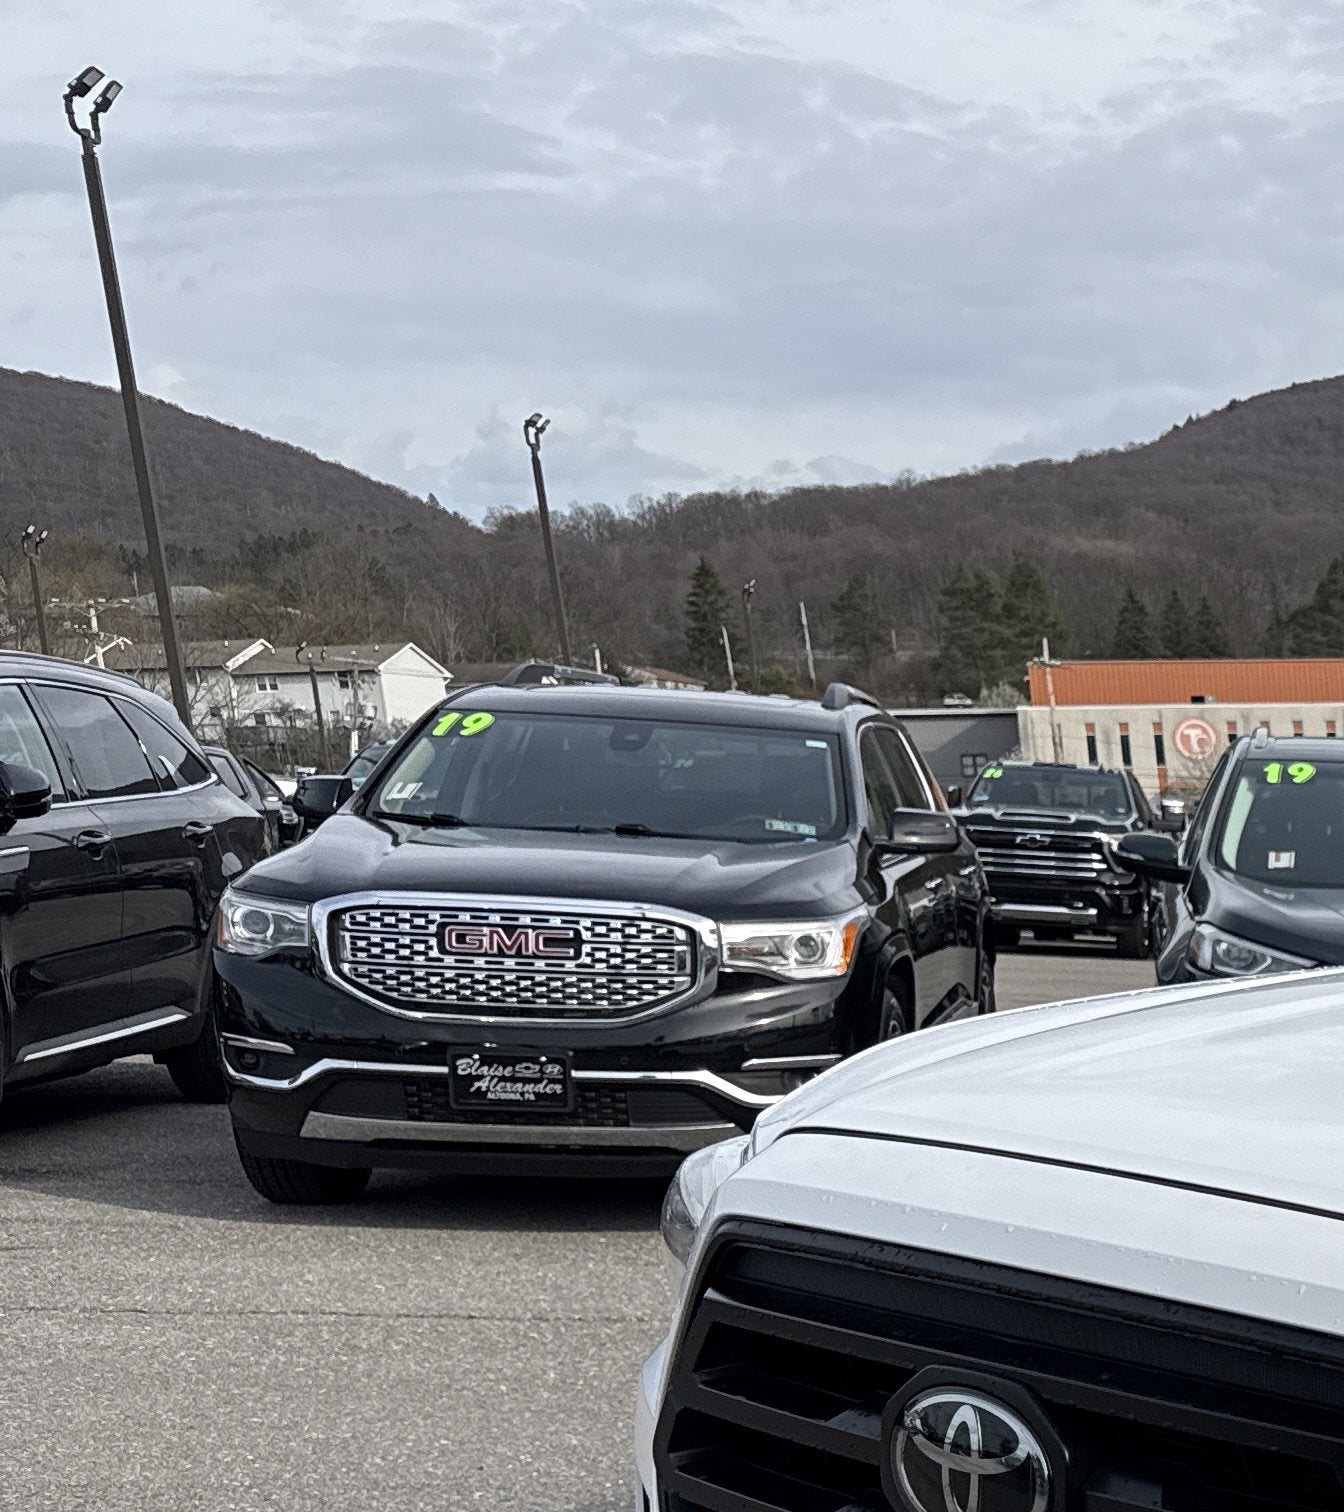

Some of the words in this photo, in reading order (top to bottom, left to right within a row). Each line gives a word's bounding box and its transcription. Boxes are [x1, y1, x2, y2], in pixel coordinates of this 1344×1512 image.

[432, 711, 496, 737] 19
[1263, 761, 1317, 784] 19
[445, 924, 575, 957] GMC
[455, 1057, 515, 1077] Blaise
[469, 1075, 564, 1095] Alexander
